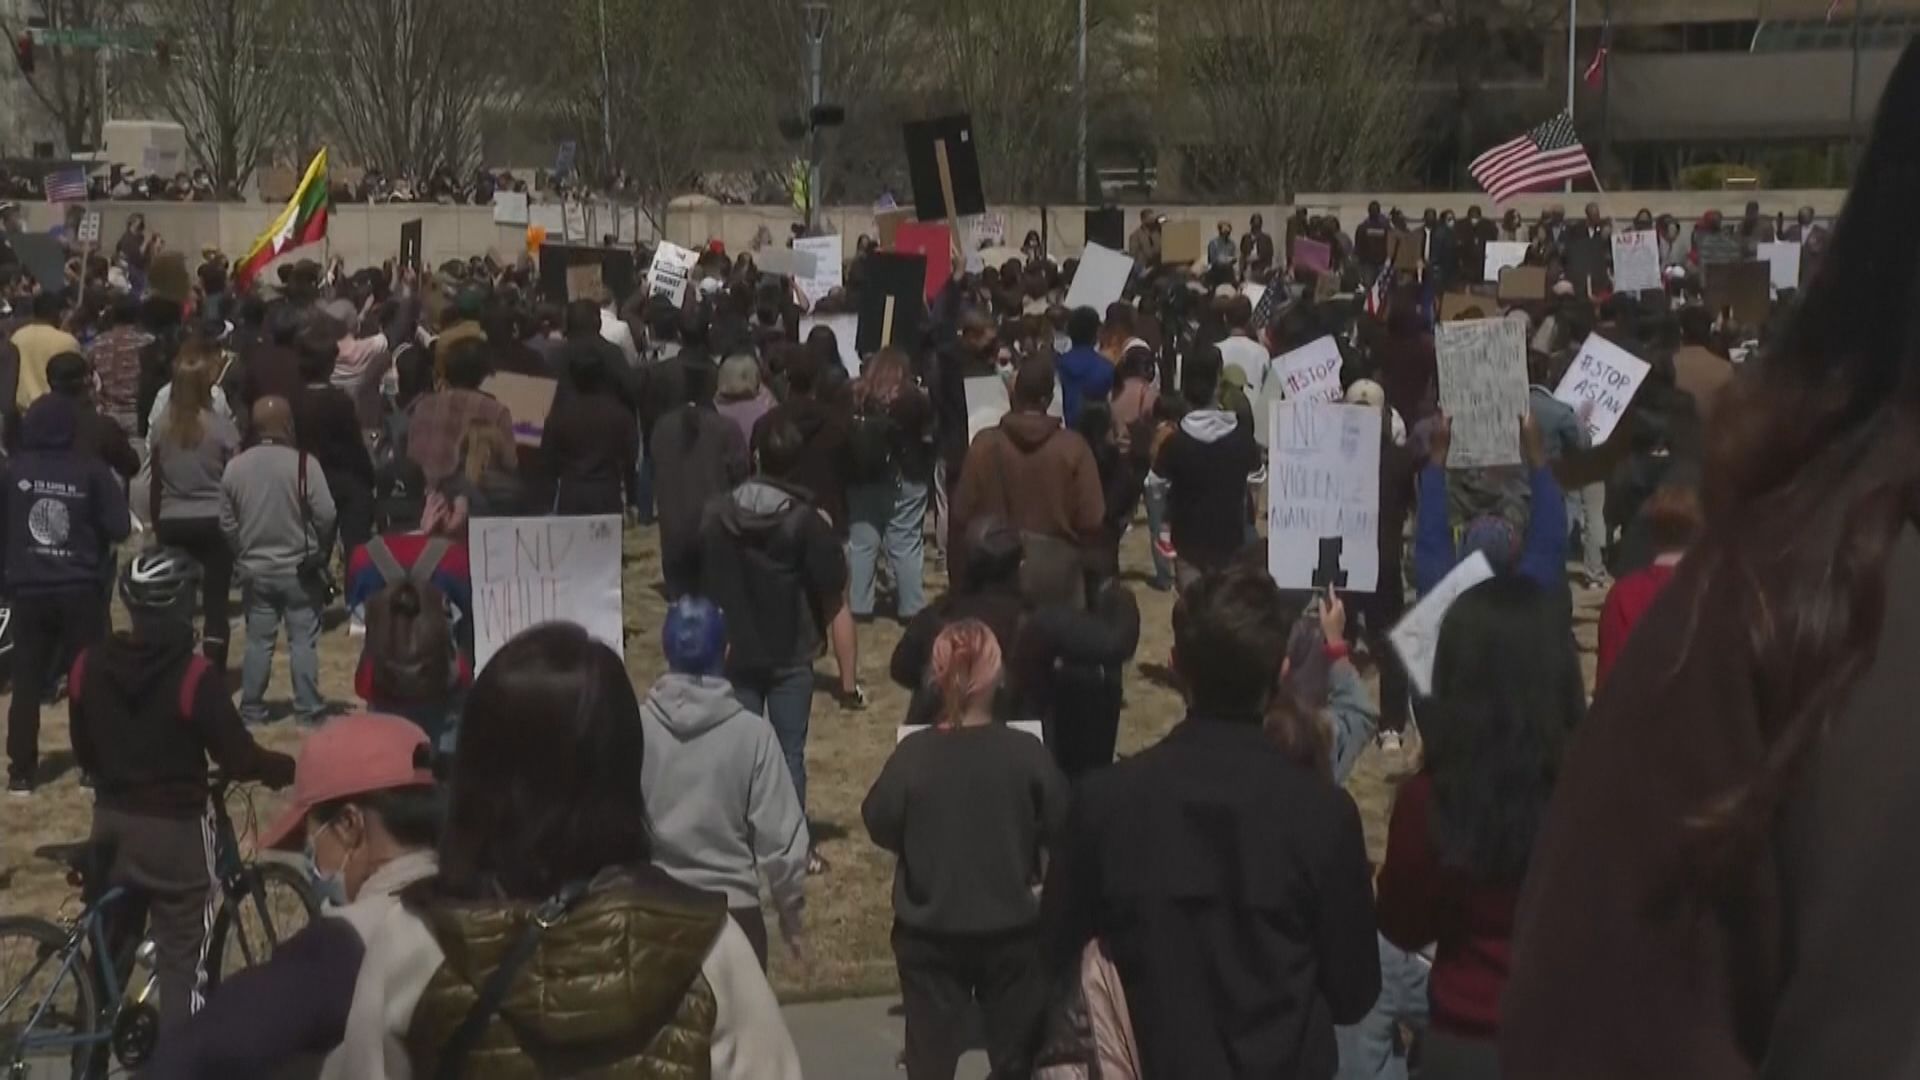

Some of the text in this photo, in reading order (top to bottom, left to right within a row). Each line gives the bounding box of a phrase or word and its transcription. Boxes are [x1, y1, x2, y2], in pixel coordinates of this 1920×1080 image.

[1286, 356, 1337, 395] #STOP
[1579, 353, 1631, 391] #STOP
[1572, 379, 1621, 415] ASIAN
[482, 522, 576, 585] END
